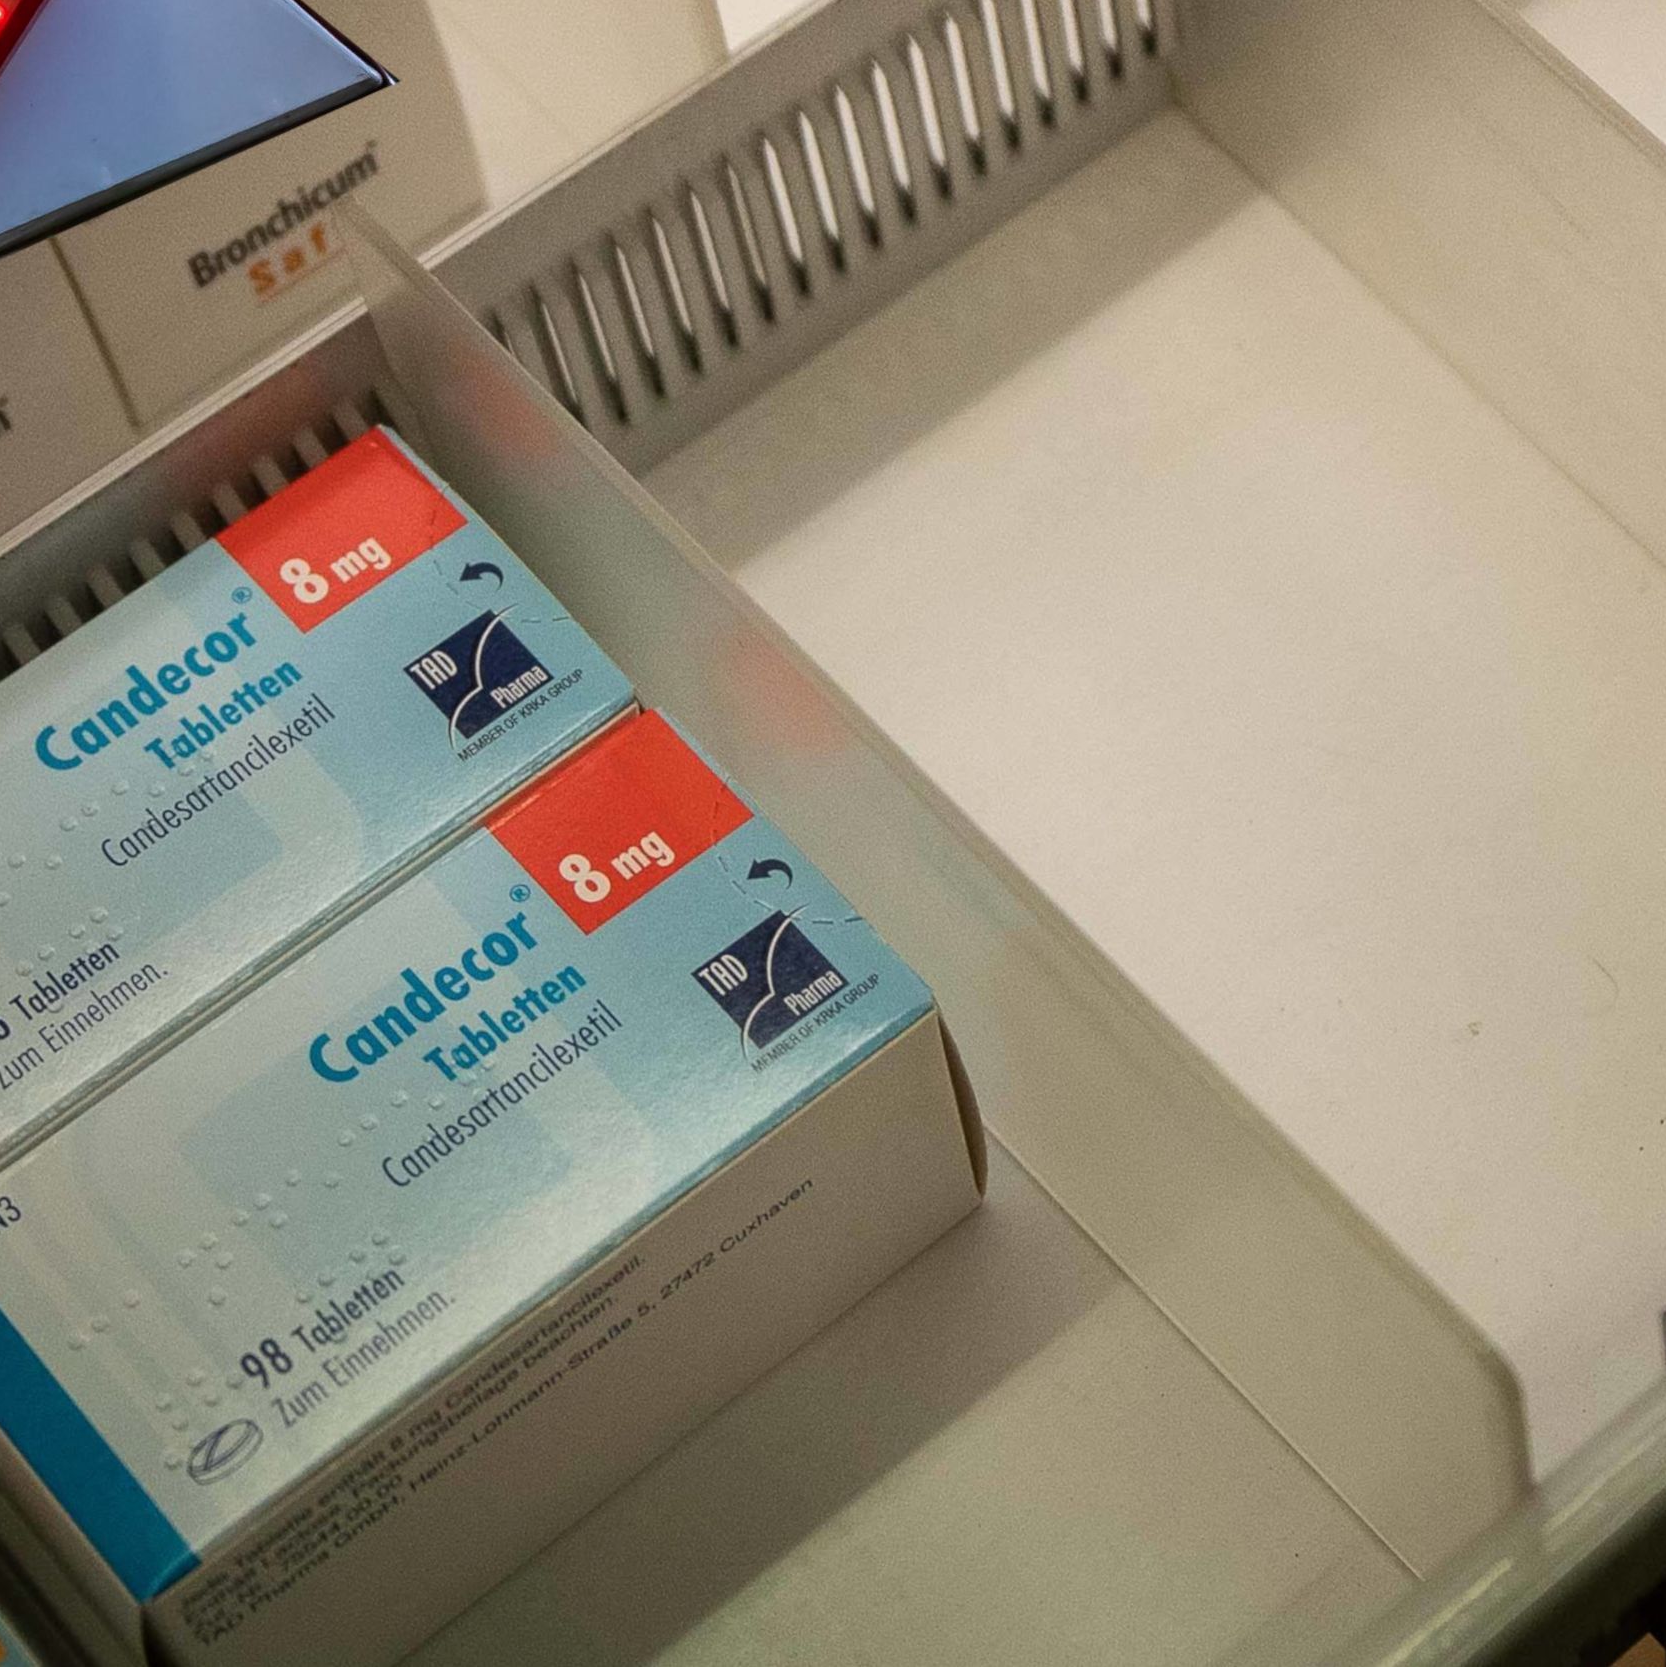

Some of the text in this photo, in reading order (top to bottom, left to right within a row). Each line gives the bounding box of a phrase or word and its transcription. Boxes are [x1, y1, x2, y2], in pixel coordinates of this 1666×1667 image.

[278, 536, 392, 605] 8 mg
[142, 657, 304, 772] Tabletten
[409, 649, 459, 691] TAD
[457, 668, 584, 763] MEMBER OF KRKA GROUP
[489, 664, 549, 709] Pharma
[100, 691, 337, 868] Candesartancilexetil
[557, 828, 676, 903] 8 mg
[8, 940, 121, 1025] Tabletten
[37, 961, 170, 1055] Einnehmen.
[421, 961, 588, 1083] Tabletten
[698, 953, 749, 997] TAD
[783, 969, 844, 1017] Pharma
[750, 972, 880, 1074] MEMBER OF KRKA GROUP
[380, 998, 624, 1189] Candesartancilexetil
[238, 1265, 406, 1391] 98 Tabletten
[269, 1287, 458, 1429] Zum Einnehmen.
[248, 1549, 330, 1614] Pharma
[659, 1251, 716, 1301] 27472
[719, 1178, 814, 1253] Cuxhaven
